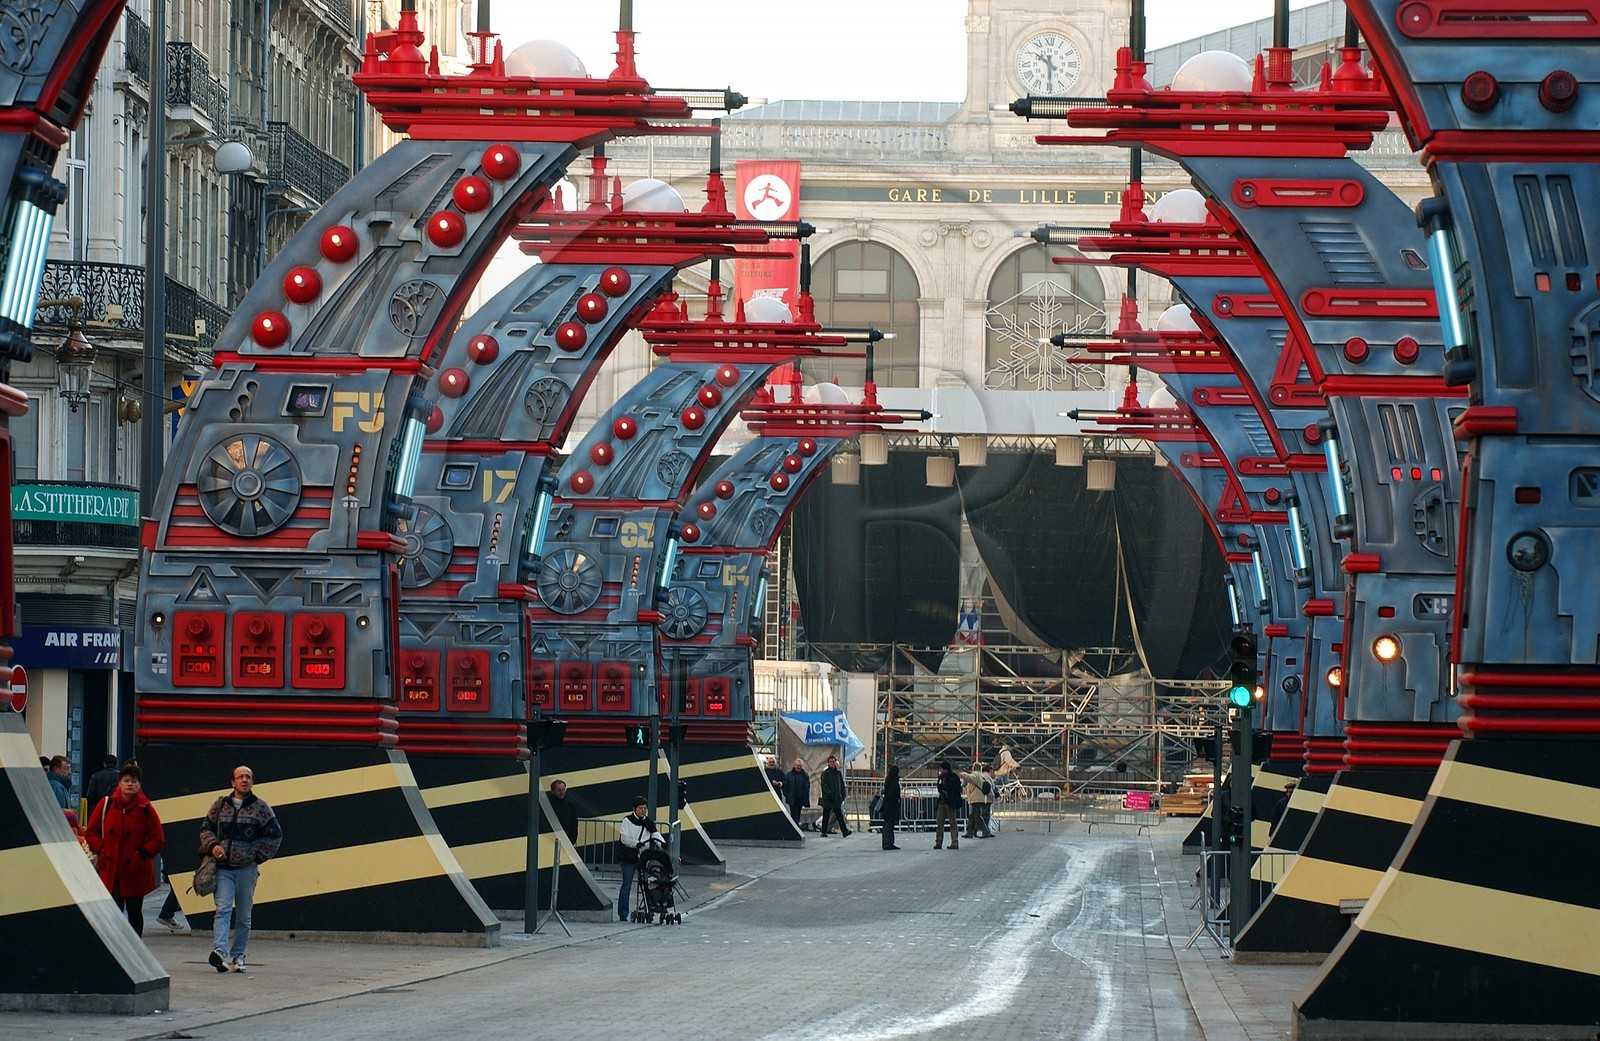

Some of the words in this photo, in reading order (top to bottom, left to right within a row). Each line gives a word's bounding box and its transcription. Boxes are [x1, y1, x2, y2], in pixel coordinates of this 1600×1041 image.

[888, 188, 943, 203] GARE
[968, 189, 993, 203] DE
[1019, 190, 1077, 204] LILLE
[14, 490, 129, 519] ASTITHERAPIE
[44, 632, 78, 647] AIR
